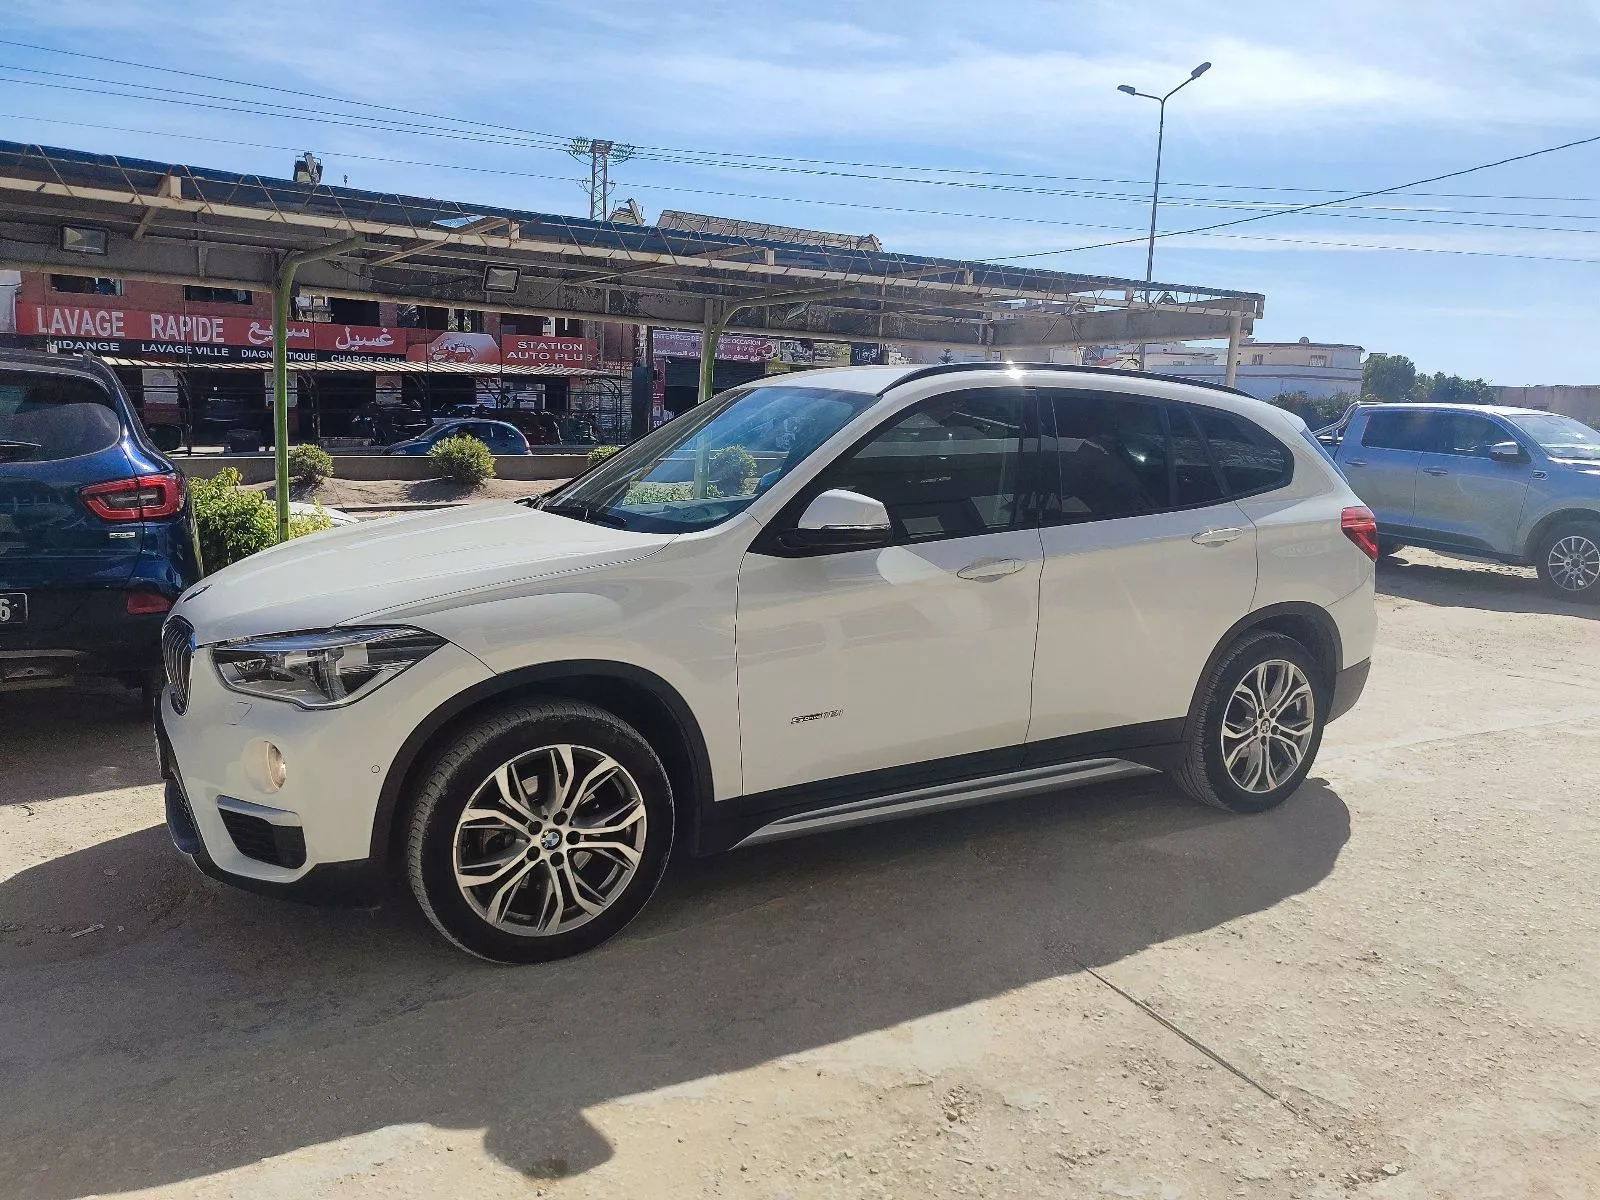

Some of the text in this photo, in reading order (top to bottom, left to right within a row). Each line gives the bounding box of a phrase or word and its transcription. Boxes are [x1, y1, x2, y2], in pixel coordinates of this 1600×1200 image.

[36, 307, 225, 343] LAVAGE RAPIDE
[248, 321, 395, 351] غسيل سيع
[141, 343, 230, 356] LAVAGE VILLE
[517, 341, 583, 351] STATION
[241, 349, 316, 361] DIAGNTIQUE
[506, 351, 593, 362] AUTO PLUS
